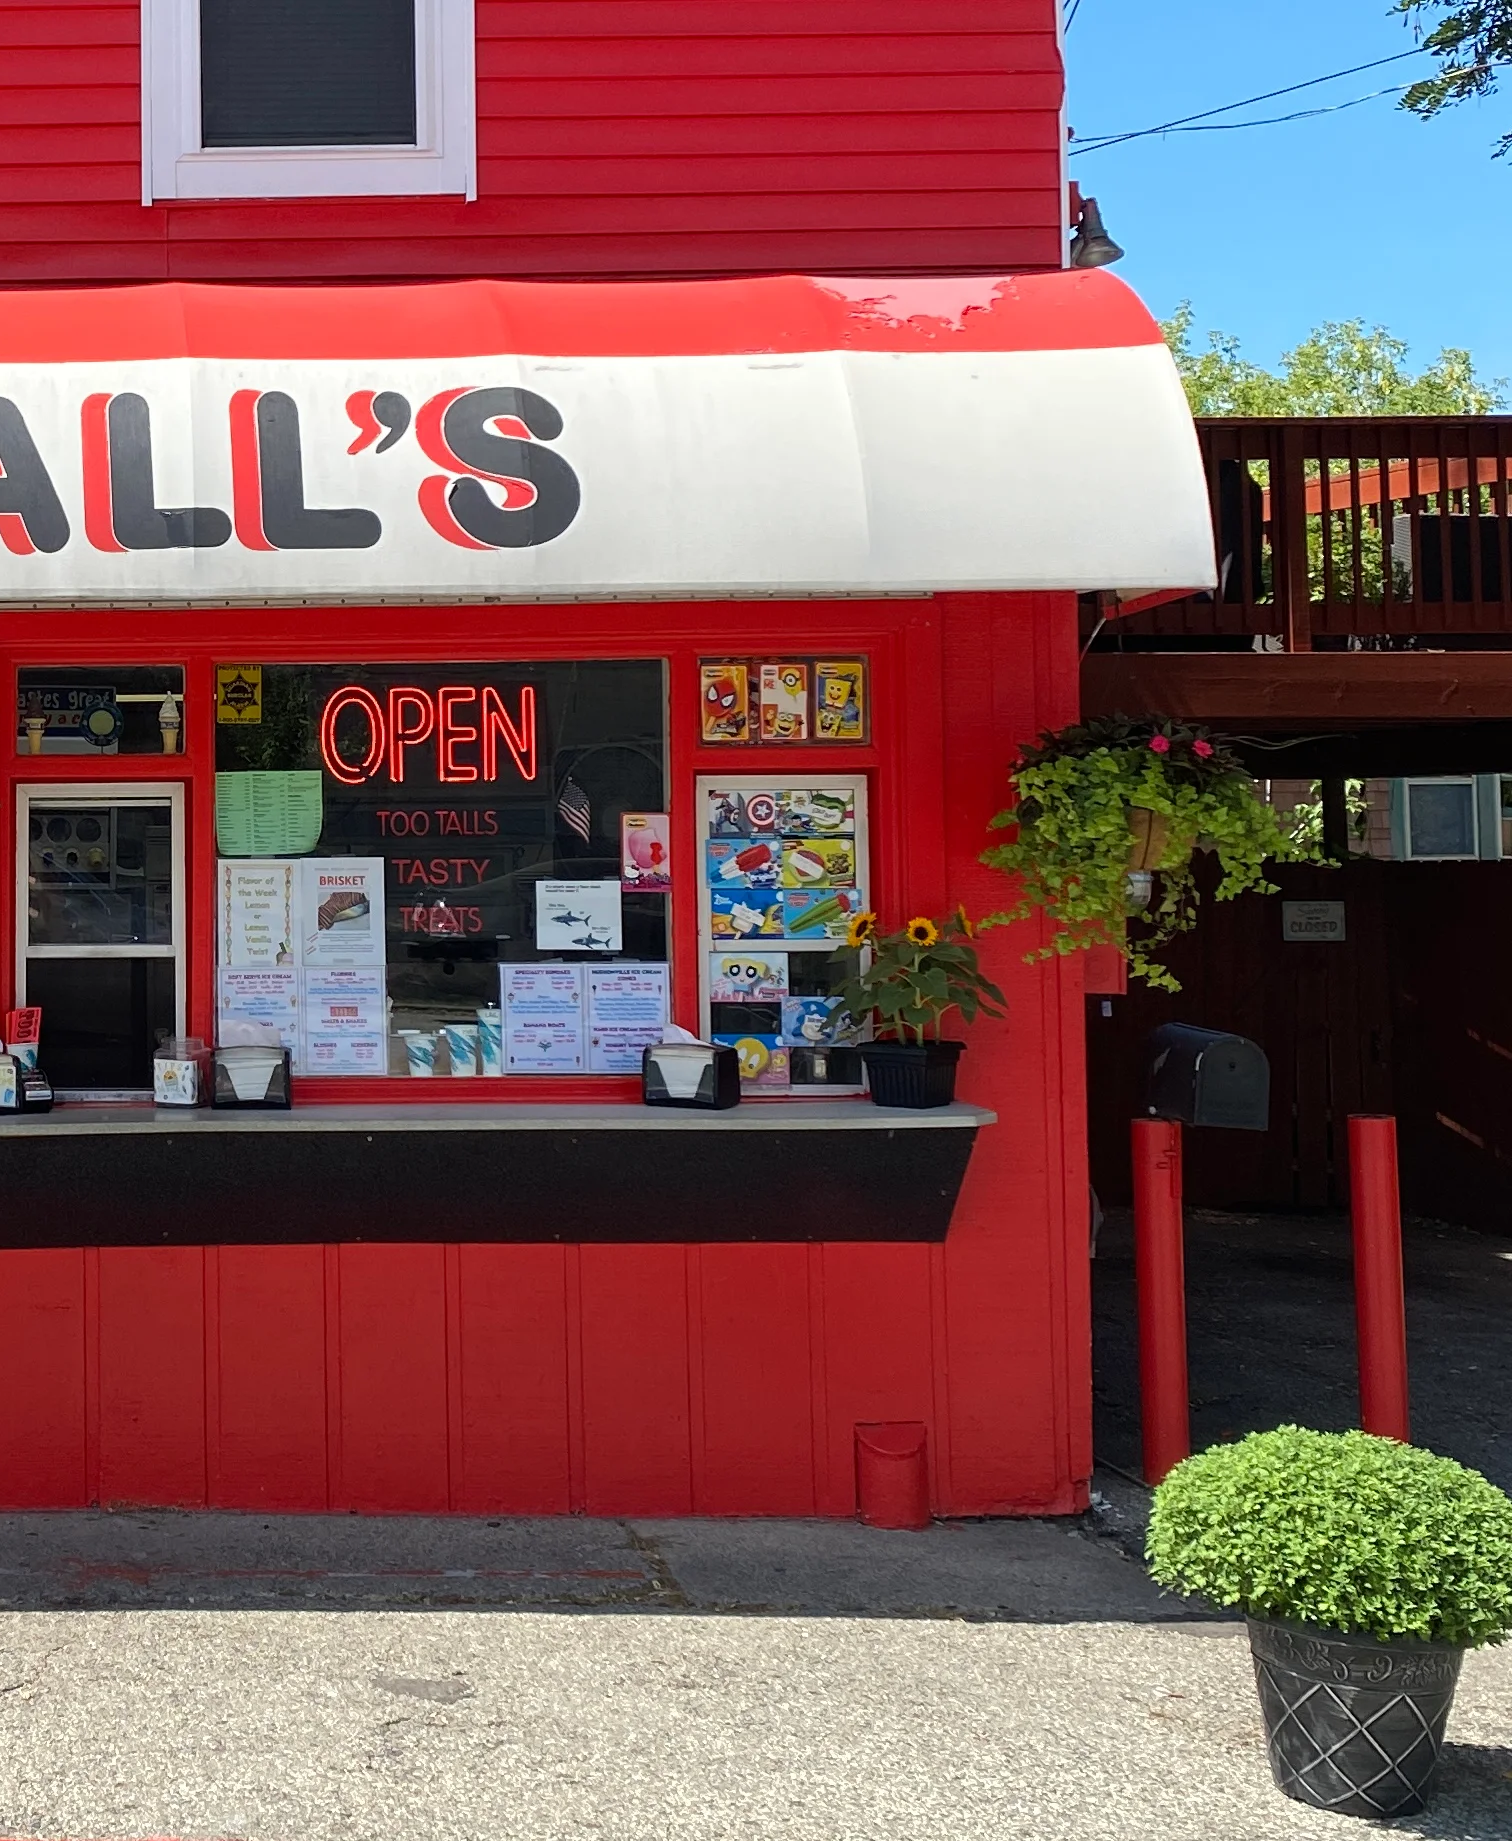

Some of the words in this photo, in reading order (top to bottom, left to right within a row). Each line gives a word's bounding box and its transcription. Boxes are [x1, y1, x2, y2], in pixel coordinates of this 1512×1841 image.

[18, 689, 59, 709] astes
[321, 686, 536, 784] OPEN
[376, 810, 430, 836] TOO
[434, 810, 499, 836] TALLS
[392, 859, 490, 884] TASTY
[238, 877, 262, 885] Flavor
[265, 877, 274, 885] of
[319, 875, 365, 886] BRISKET
[238, 889, 252, 897] the
[255, 889, 277, 897] Week
[245, 901, 270, 909] Lemon
[399, 906, 483, 933] TREATS
[1290, 921, 1337, 933] CLOSED
